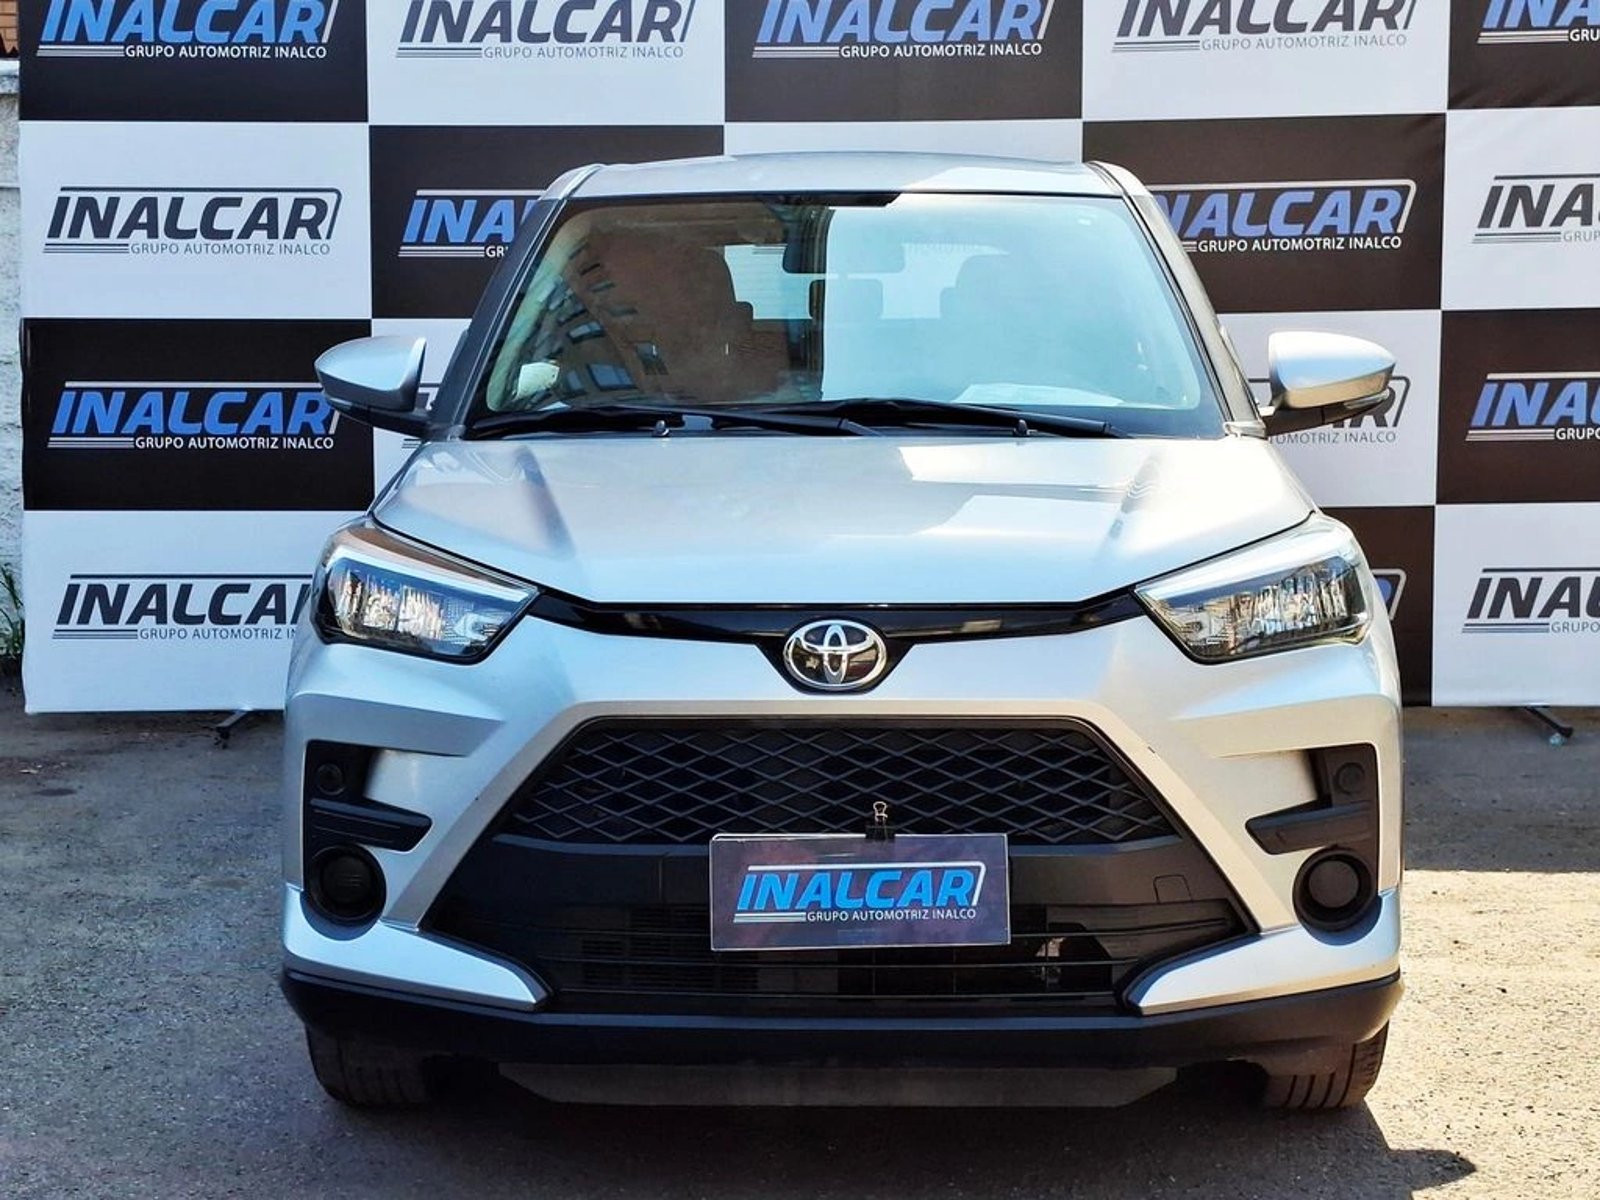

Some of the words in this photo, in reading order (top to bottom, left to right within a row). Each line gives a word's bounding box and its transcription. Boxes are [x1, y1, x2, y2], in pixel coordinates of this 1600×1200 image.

[40, 0, 325, 43] INALCAR
[400, 0, 682, 43] INALCAR
[756, 0, 1042, 43] INALCAR
[1117, 0, 1401, 37] INALCAR
[840, 44, 890, 58] GRUPO
[894, 43, 985, 57] AUTOMOTRIZ
[990, 42, 1042, 56] INALCO
[1202, 38, 1251, 51] GRUPO
[1256, 36, 1350, 50] AUTOMOTRIZ
[1354, 33, 1407, 47] INALCO
[125, 45, 174, 58] GRUPO
[178, 45, 270, 59] AUTOMOTRIZ
[274, 45, 328, 59] INALCO
[483, 46, 533, 59] GRUPO
[537, 46, 628, 59] AUTOMOTRIZ
[632, 46, 684, 59] INALCO
[1154, 189, 1402, 239] NALCAR
[1478, 183, 1600, 228] INA
[47, 196, 329, 240] INALCAR
[130, 243, 180, 255] GRUPO
[184, 243, 274, 256] AUTOMOTRIZ
[279, 243, 330, 256] INALCO
[1198, 239, 1248, 253] GRUPO
[1252, 236, 1345, 252] AUTOMOTRIZ
[1349, 235, 1402, 249] INALCO
[51, 391, 332, 435] INALCAR
[135, 437, 184, 450] GRUPO
[188, 437, 279, 450] AUTOMOTRIZ
[283, 436, 334, 450] INALCO
[1344, 430, 1397, 444] INALCO
[139, 628, 188, 640] GRUPO
[192, 627, 282, 640] AUTOMOTRIZ
[737, 869, 976, 911] INALCAR
[807, 910, 849, 923] GRUPO
[852, 910, 930, 922] AUTOMOTRIZ
[932, 908, 977, 921] INALCO
